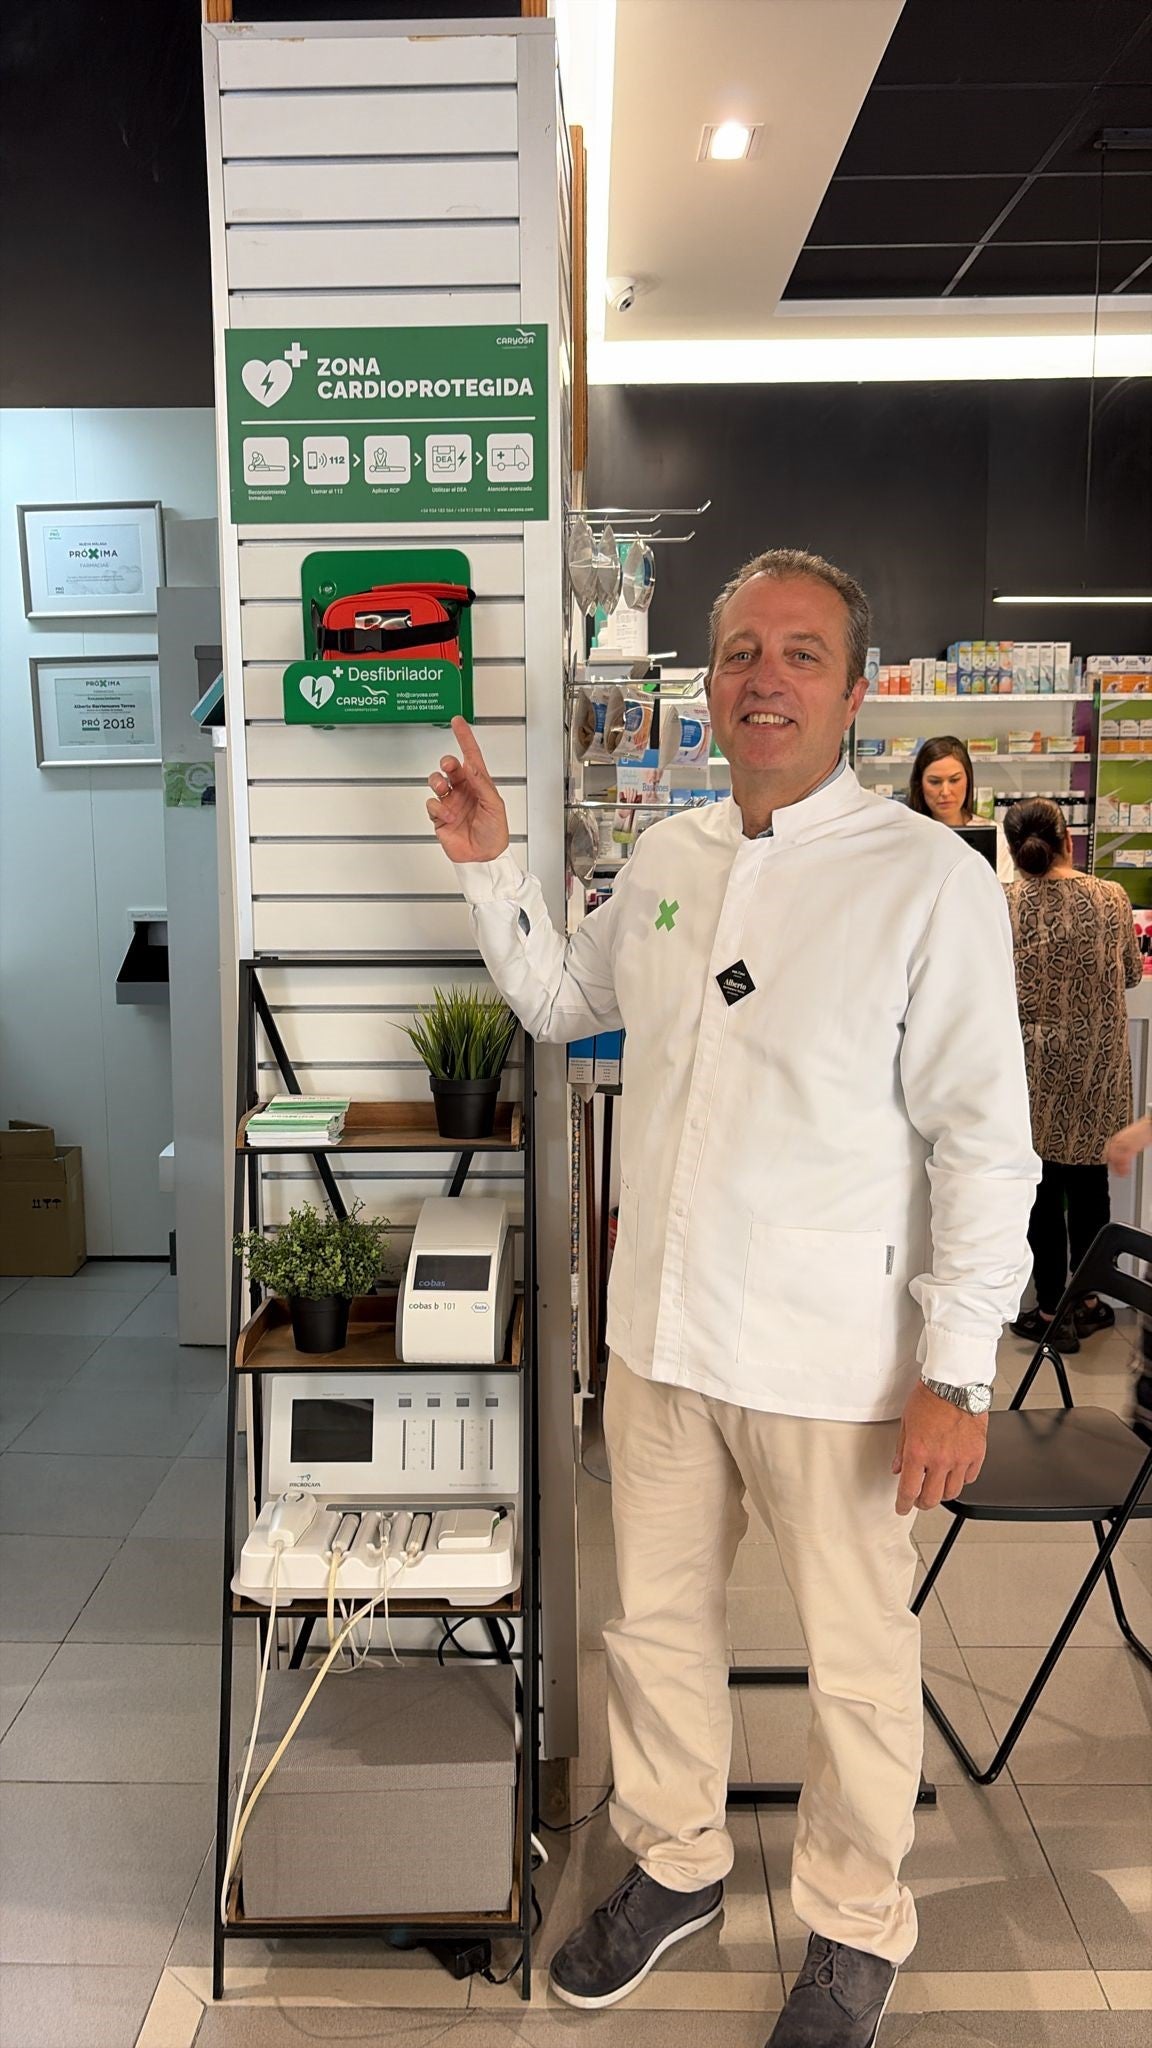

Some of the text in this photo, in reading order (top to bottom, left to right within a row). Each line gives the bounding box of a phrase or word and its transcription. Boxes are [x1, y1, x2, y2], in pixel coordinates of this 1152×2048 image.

[496, 336, 534, 345] CARYOSA
[317, 357, 381, 376] ZONA
[317, 378, 534, 400] CARDIOPROTEGIDA
[329, 455, 345, 465] 112
[435, 455, 453, 464] DEA
[69, 548, 118, 560] PRÓXIMA
[348, 666, 443, 681] Desfibrilador
[85, 679, 120, 688] PRÓXIMA
[336, 696, 386, 706] CARYOSA
[103, 716, 135, 730] 2018
[724, 979, 747, 990] Alberto
[418, 1279, 446, 1287] cobas
[408, 1302, 456, 1310] cobas b 101
